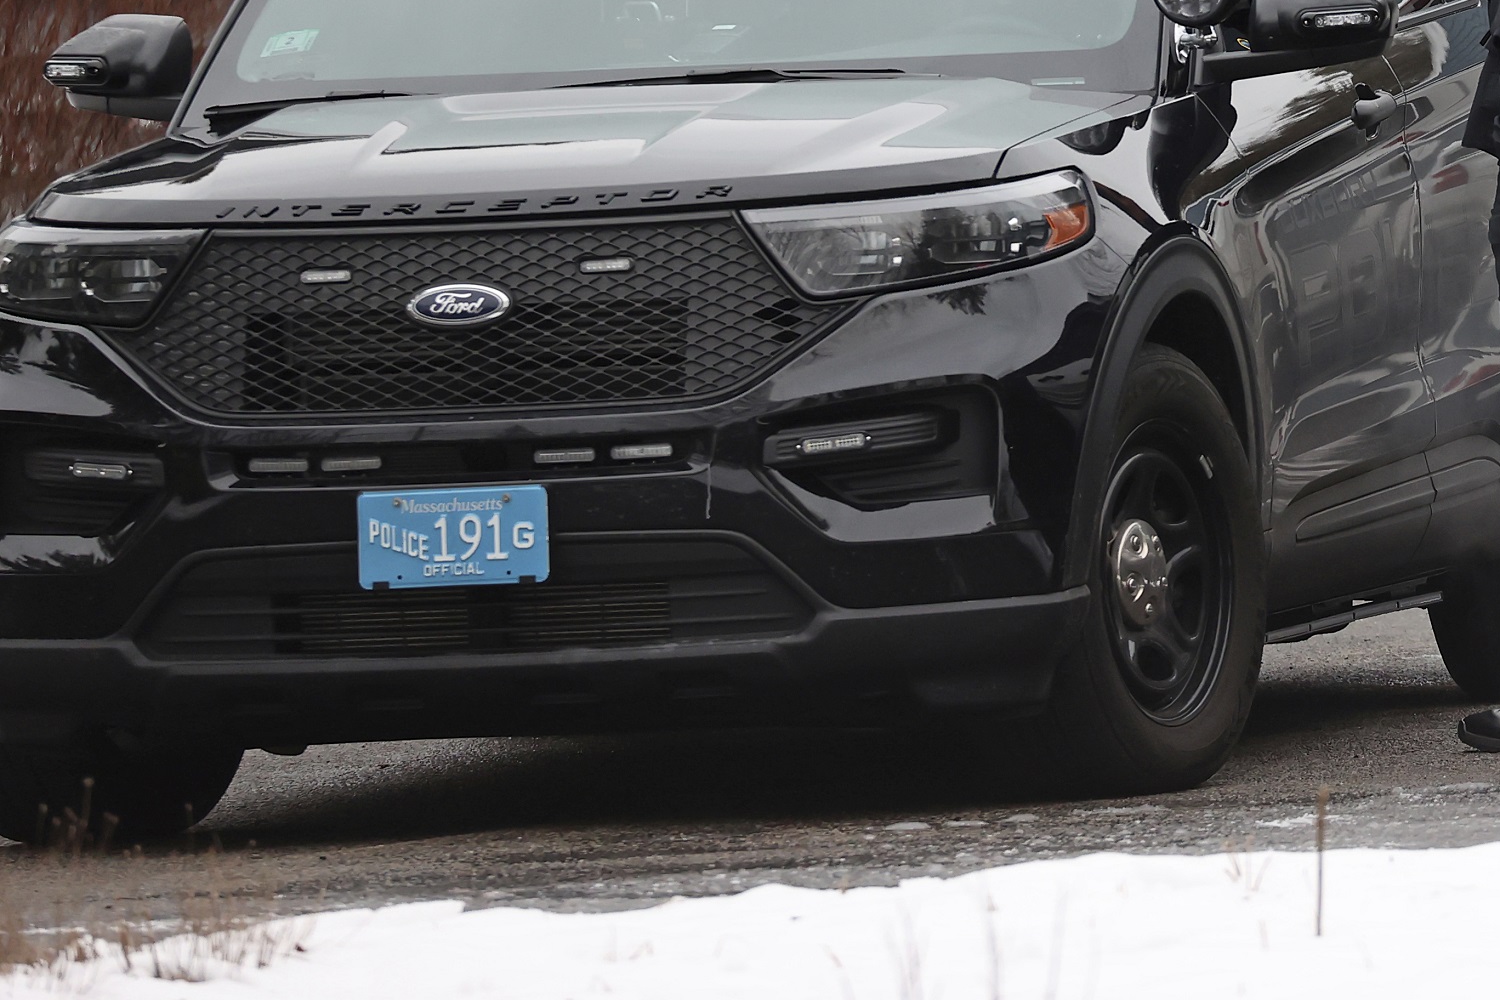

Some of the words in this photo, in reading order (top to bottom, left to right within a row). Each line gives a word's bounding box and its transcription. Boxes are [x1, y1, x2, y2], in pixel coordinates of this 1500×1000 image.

[216, 184, 734, 219] INTERCEPTOR
[429, 292, 486, 314] Ford
[401, 497, 503, 515] Massachusetts
[368, 518, 430, 562] POLICE
[423, 562, 485, 577] OFFICIAL
